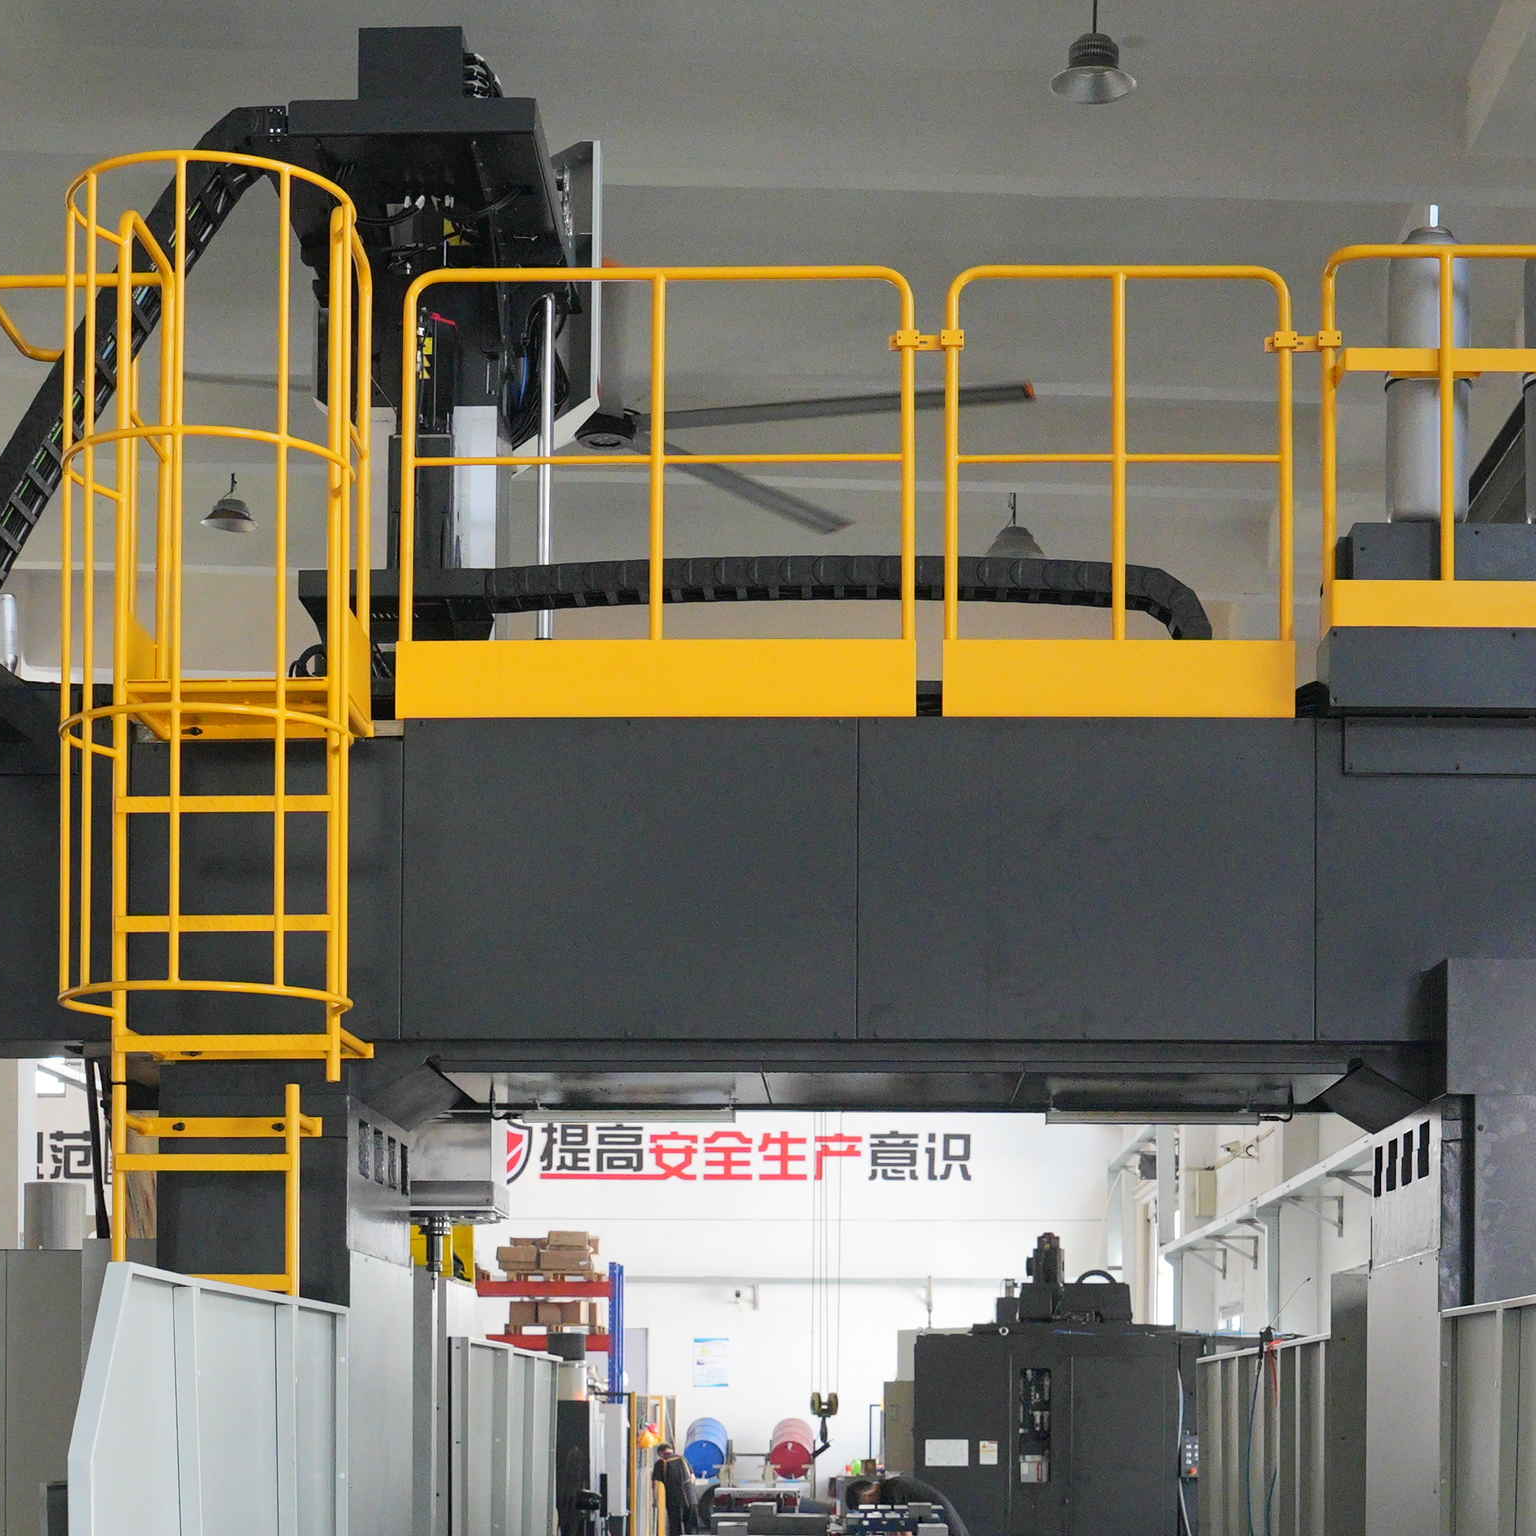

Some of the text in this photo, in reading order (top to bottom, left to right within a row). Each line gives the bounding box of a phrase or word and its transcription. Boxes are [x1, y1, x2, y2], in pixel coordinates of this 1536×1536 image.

[539, 1123, 972, 1181] 提高安全生产意识
